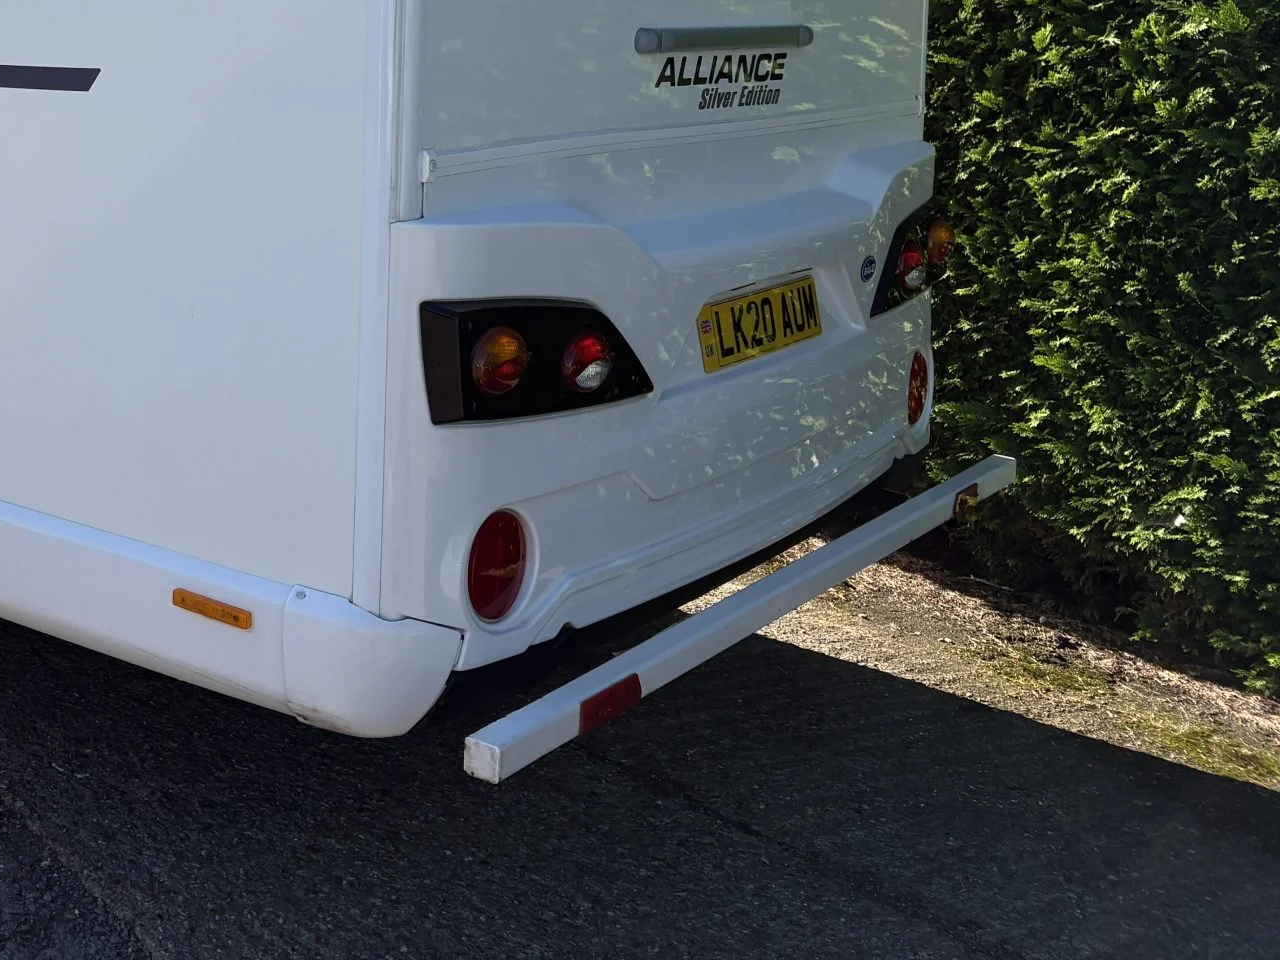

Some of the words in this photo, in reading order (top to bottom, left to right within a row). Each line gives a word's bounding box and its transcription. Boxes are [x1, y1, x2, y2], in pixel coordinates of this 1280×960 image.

[655, 52, 787, 88] ALLIANCE
[699, 87, 737, 110] Silver
[738, 85, 780, 107] Edition
[715, 297, 776, 358] LK20
[781, 284, 818, 338] AUM
